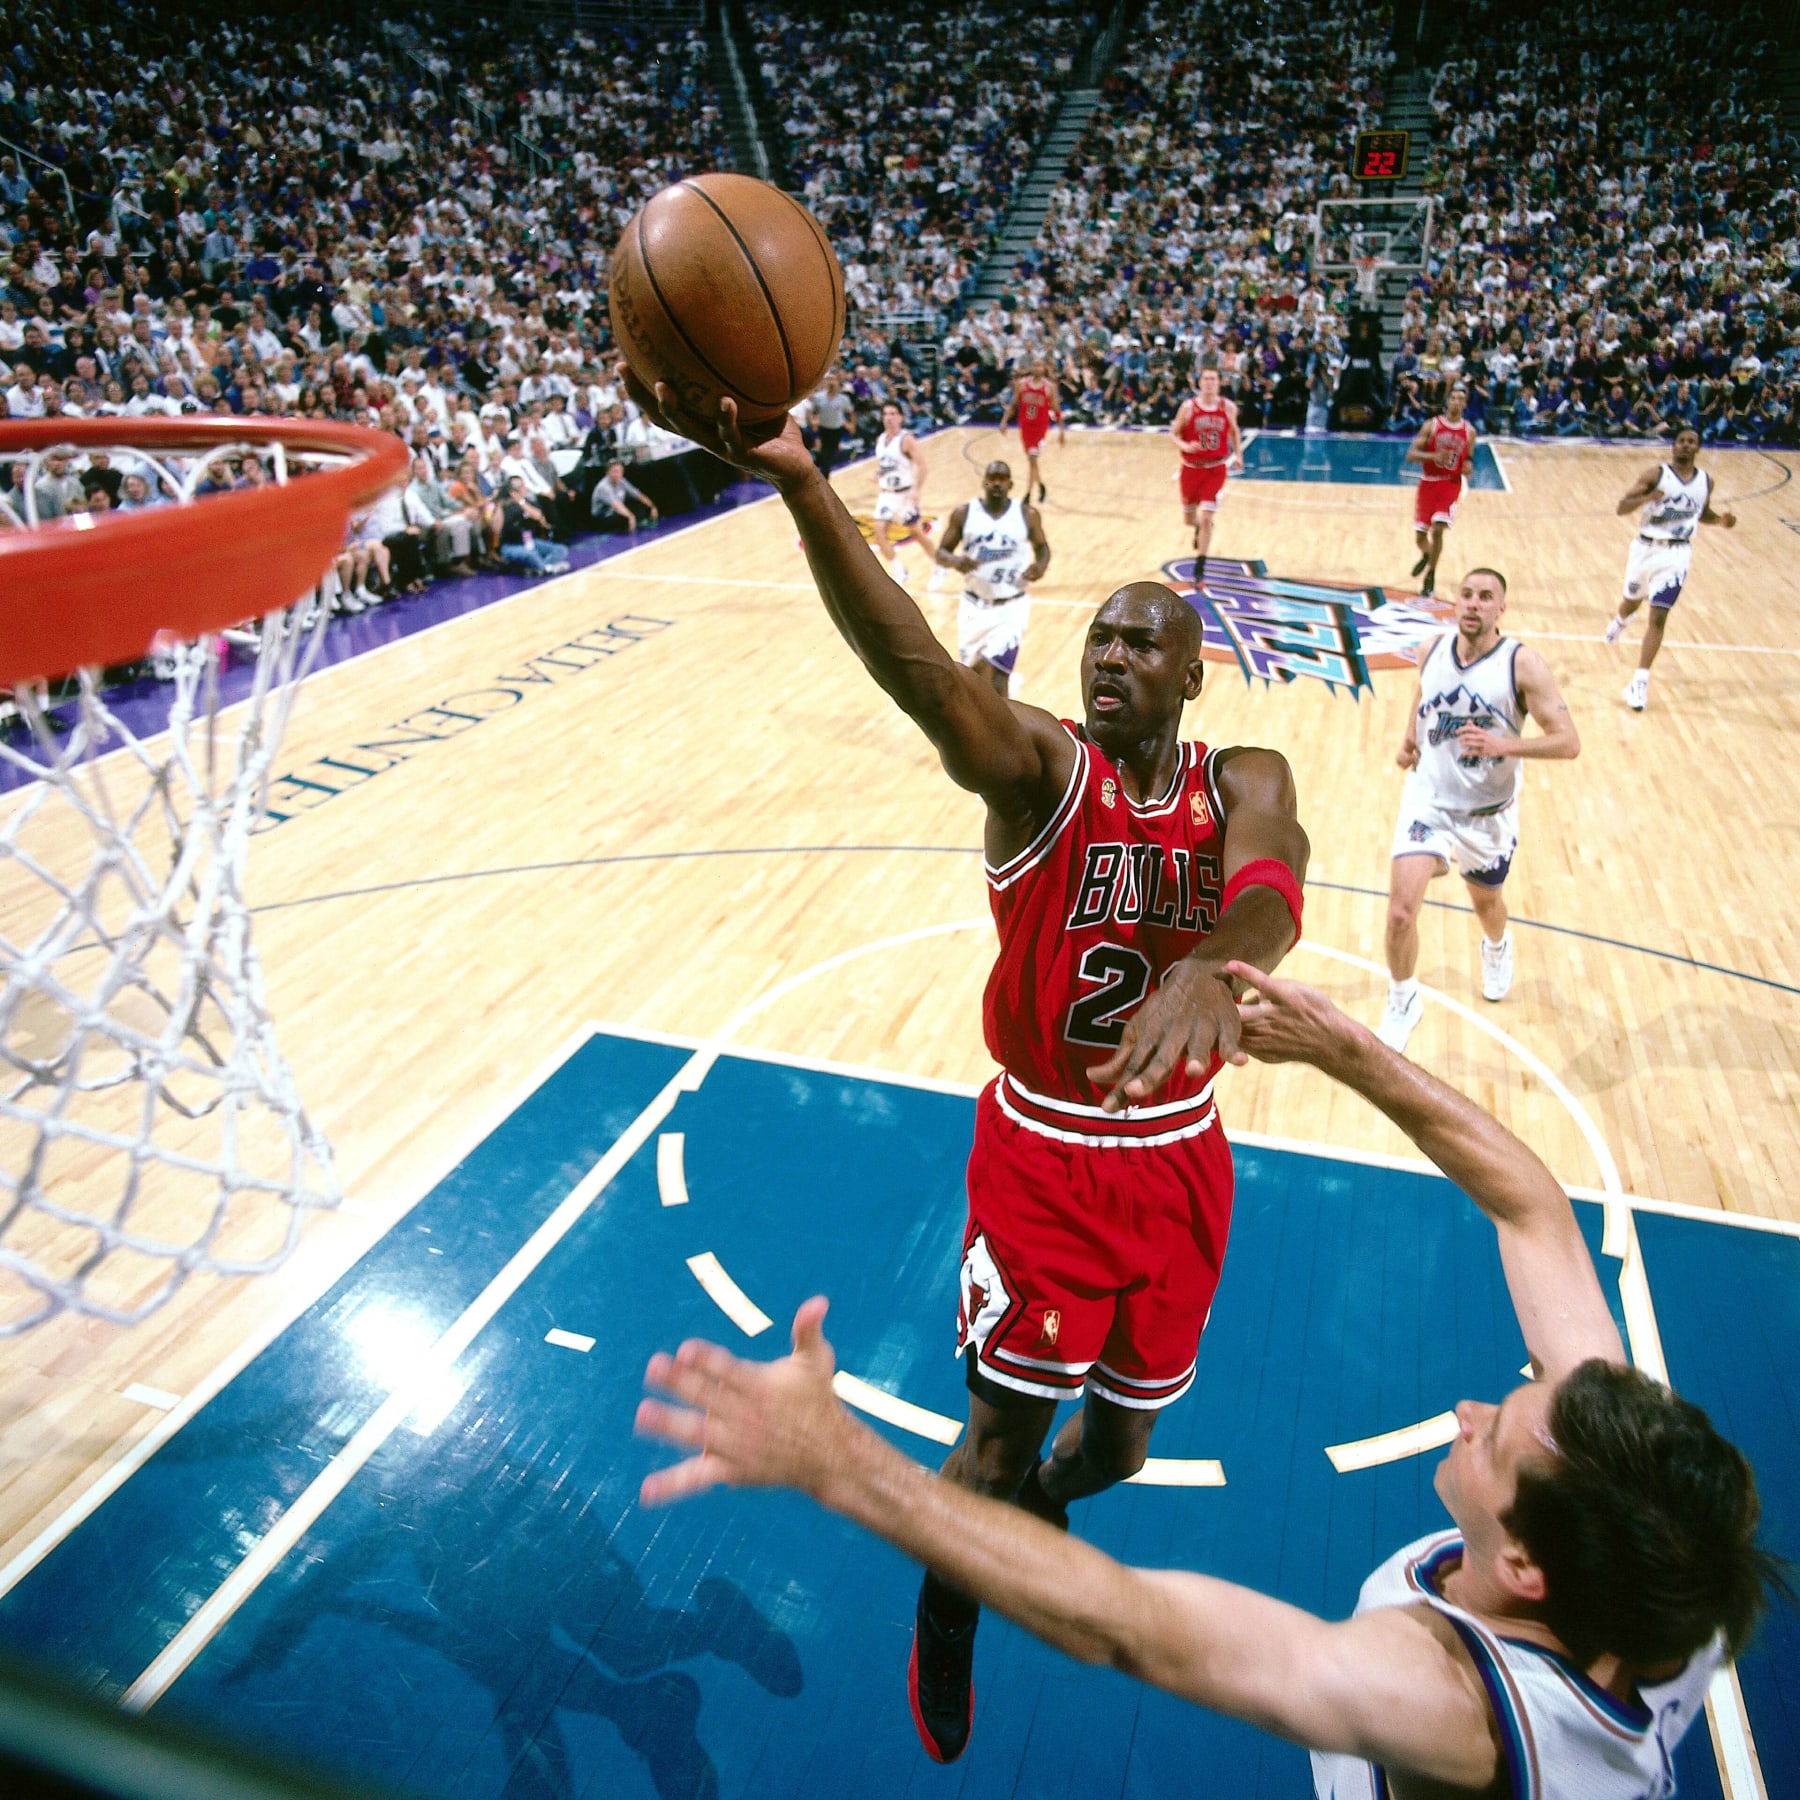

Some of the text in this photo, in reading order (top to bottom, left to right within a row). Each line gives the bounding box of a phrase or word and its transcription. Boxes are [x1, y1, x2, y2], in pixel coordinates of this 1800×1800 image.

[1364, 152, 1395, 175] 22
[991, 568, 1016, 584] 55
[496, 613, 677, 686] DELTA
[1066, 842, 1222, 934] BULLS
